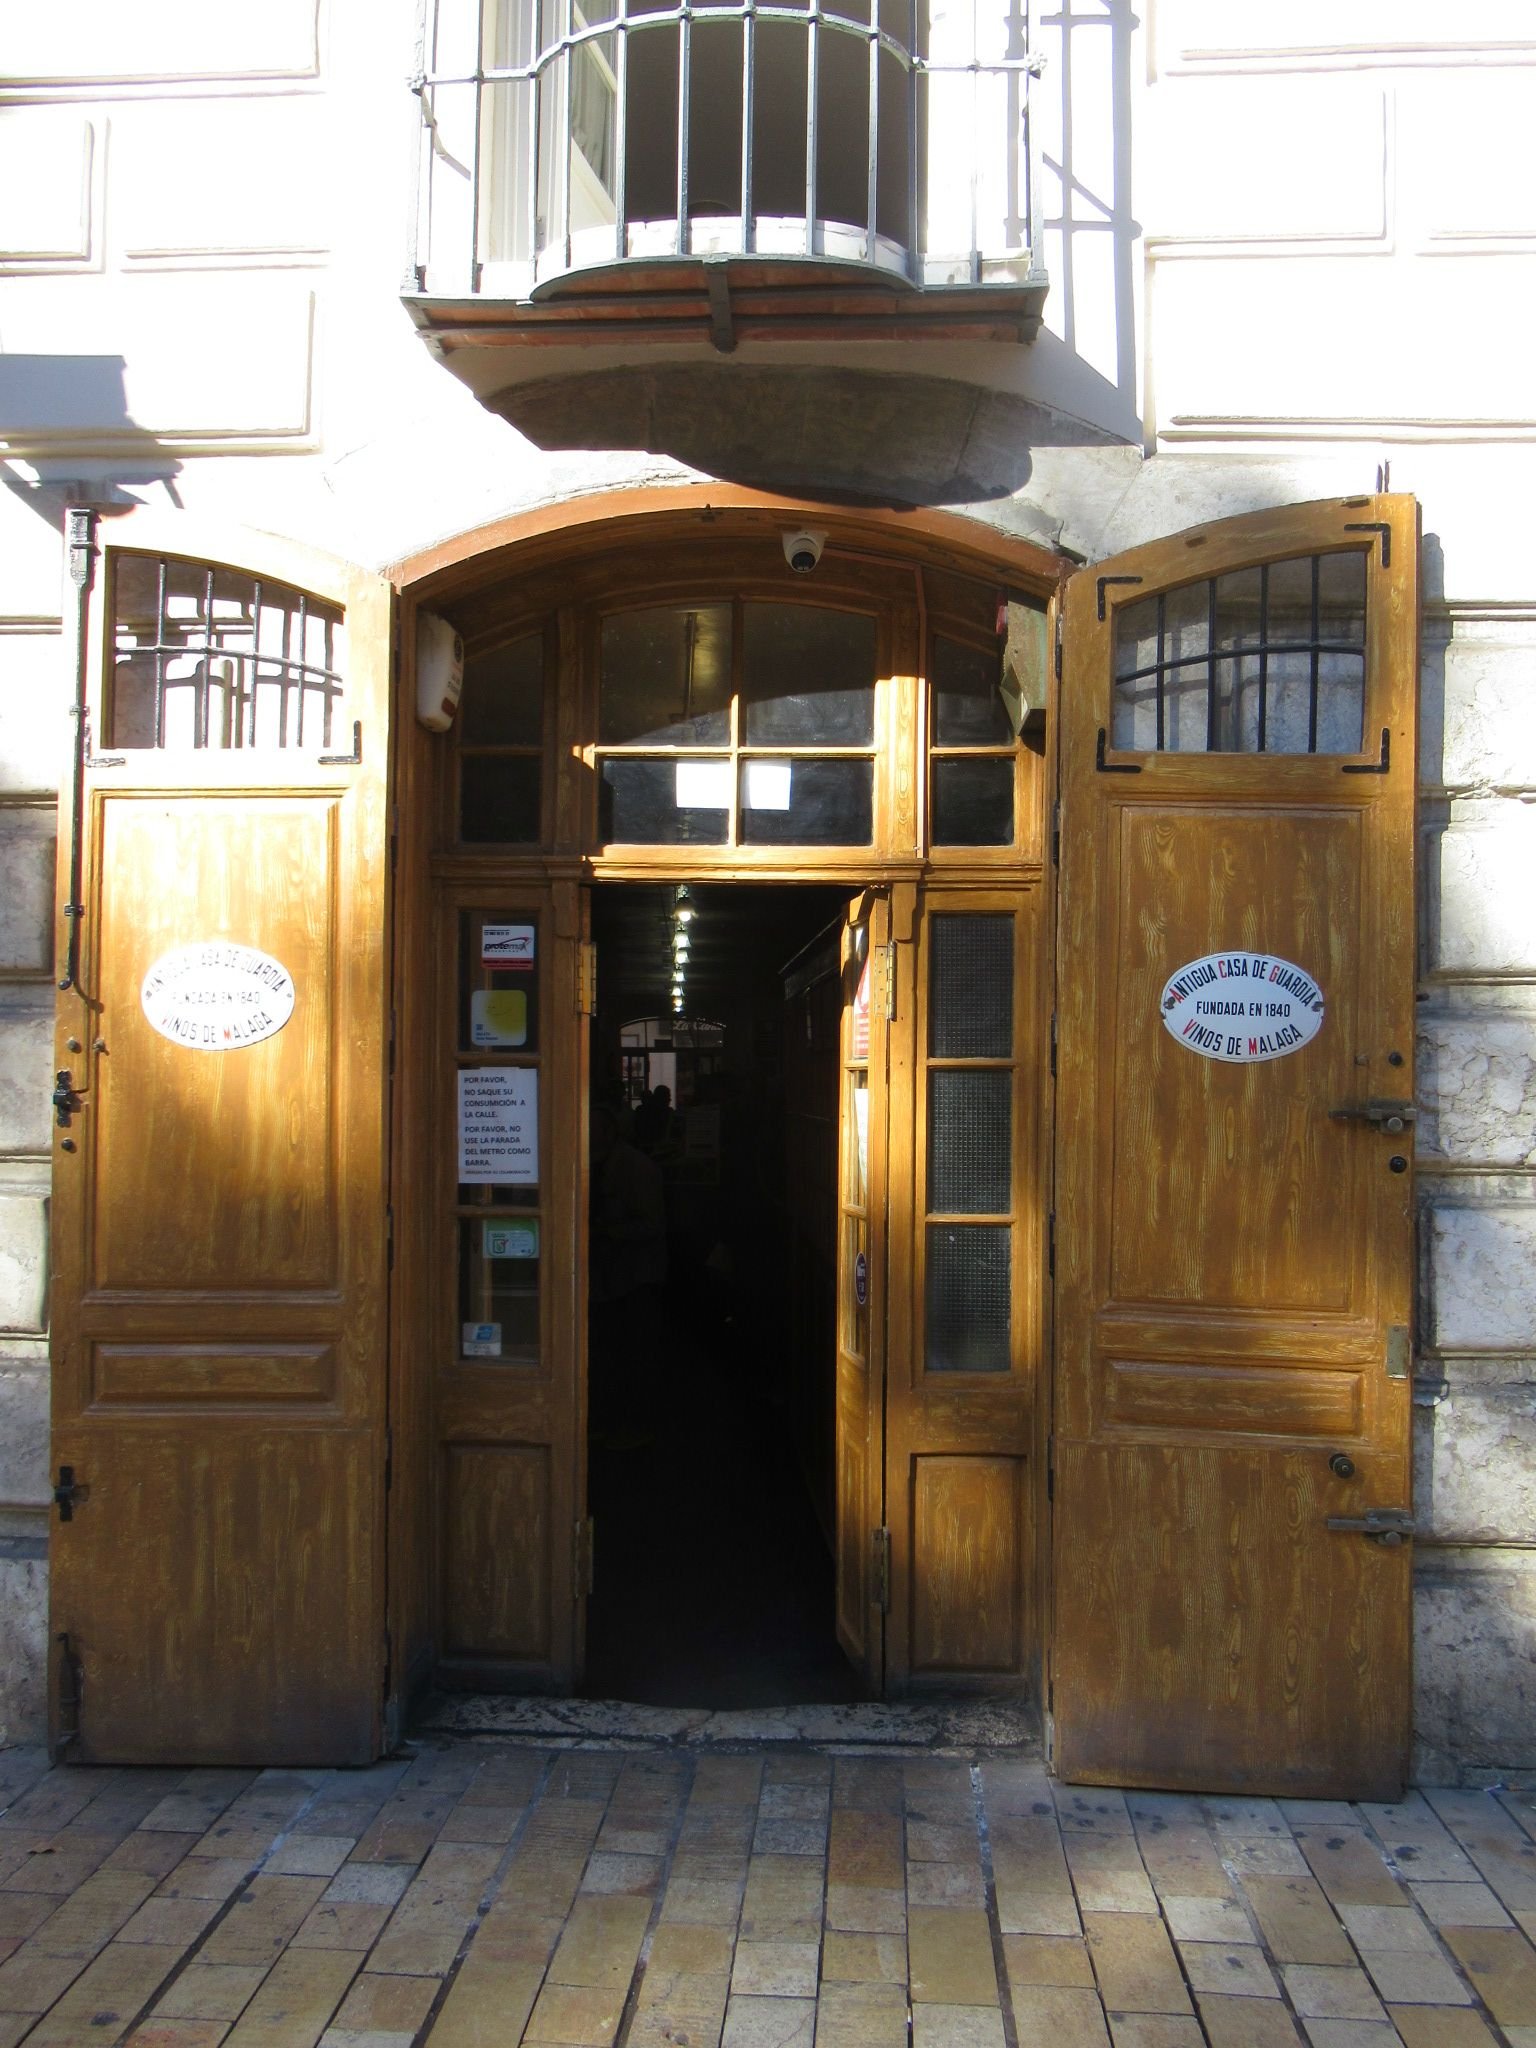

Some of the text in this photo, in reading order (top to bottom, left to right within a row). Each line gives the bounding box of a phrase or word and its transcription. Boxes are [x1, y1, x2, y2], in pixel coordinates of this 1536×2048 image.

[224, 949, 240, 968] DE
[1169, 958, 1317, 1008] ANTIGUA CASA DE GUARDIA
[237, 991, 260, 1005] 840
[1196, 1001, 1291, 1018] FUNDADA EN 1840
[203, 1025, 217, 1043] DE
[223, 1010, 274, 1042] MALAGA
[1182, 1018, 1303, 1056] VINOS DE MALAGA
[464, 1076, 508, 1084] POR FAVOR,
[477, 1088, 502, 1097] SAQUE
[503, 1088, 513, 1096] SU
[464, 1111, 474, 1119] LA
[481, 1125, 508, 1133] FAVOR,
[509, 1125, 521, 1133] NO
[490, 1136, 521, 1144] PARADA
[465, 1147, 531, 1156] DEL METRO COMO
[465, 1159, 492, 1167] BARRA.
